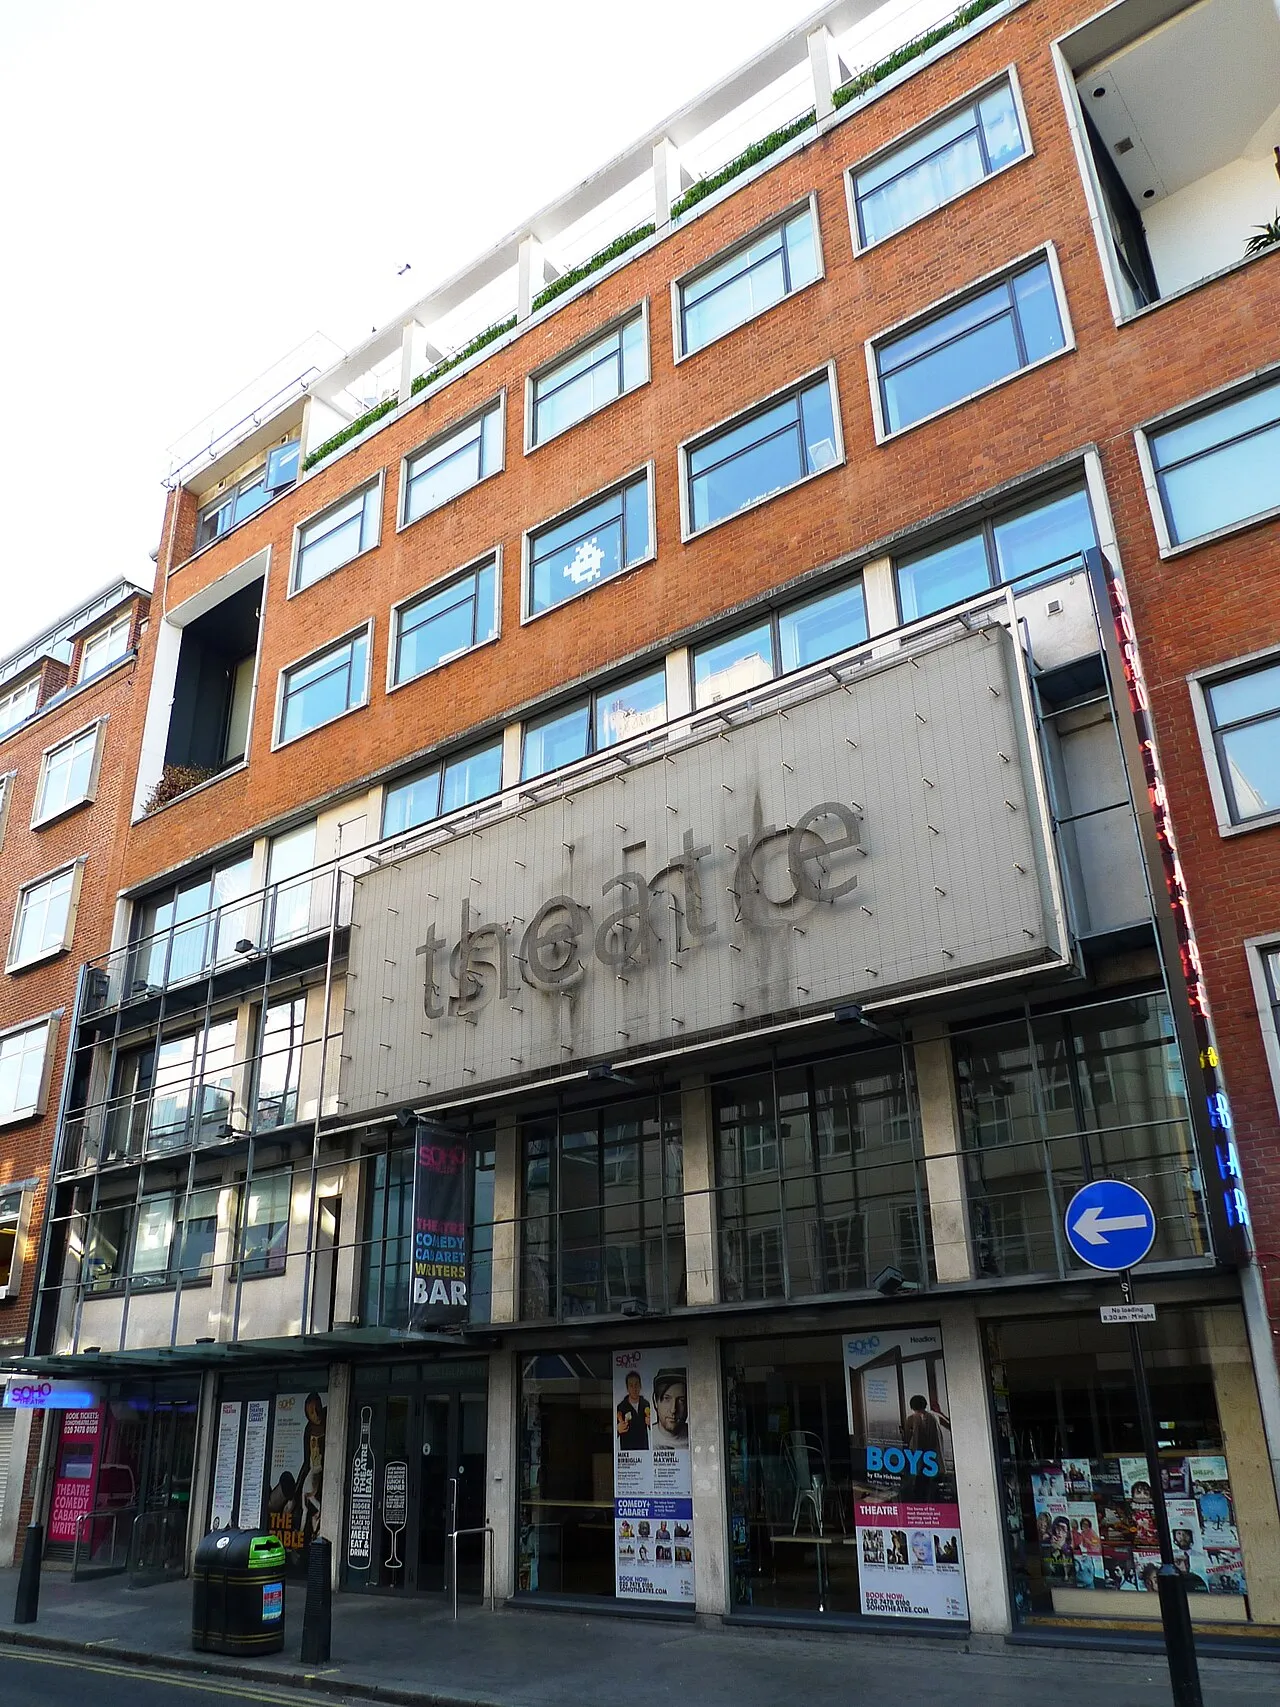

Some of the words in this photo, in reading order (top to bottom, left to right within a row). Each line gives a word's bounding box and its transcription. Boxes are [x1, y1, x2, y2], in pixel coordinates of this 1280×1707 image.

[415, 801, 862, 1020] theatre
[415, 1232, 465, 1250] COMEDY
[415, 1248, 466, 1263] CABARET
[415, 1262, 466, 1278] WRITERS
[413, 1277, 468, 1306] BAR
[847, 1335, 880, 1354] SOHO
[615, 1351, 641, 1367] SOHO
[12, 1382, 52, 1402] SOHO
[65, 1412, 79, 1420] BOOK
[360, 1443, 368, 1493] THEATRE
[866, 1445, 939, 1477] BOYS
[353, 1457, 361, 1493] SOHO
[365, 1469, 373, 1493] BAR
[57, 1483, 90, 1496] THEATRE
[54, 1496, 89, 1510] COMEDY
[860, 1505, 898, 1515] THEATRE
[618, 1508, 649, 1517] CABARET
[269, 1512, 293, 1529] THE
[52, 1521, 85, 1536] WRITE
[350, 1530, 370, 1540] MEET
[350, 1539, 362, 1548] EAT
[363, 1540, 369, 1549] &
[349, 1548, 369, 1557] DRINK
[865, 1591, 884, 1599] BOOK
[866, 1604, 930, 1614] SOHOTHEATRE.COM
